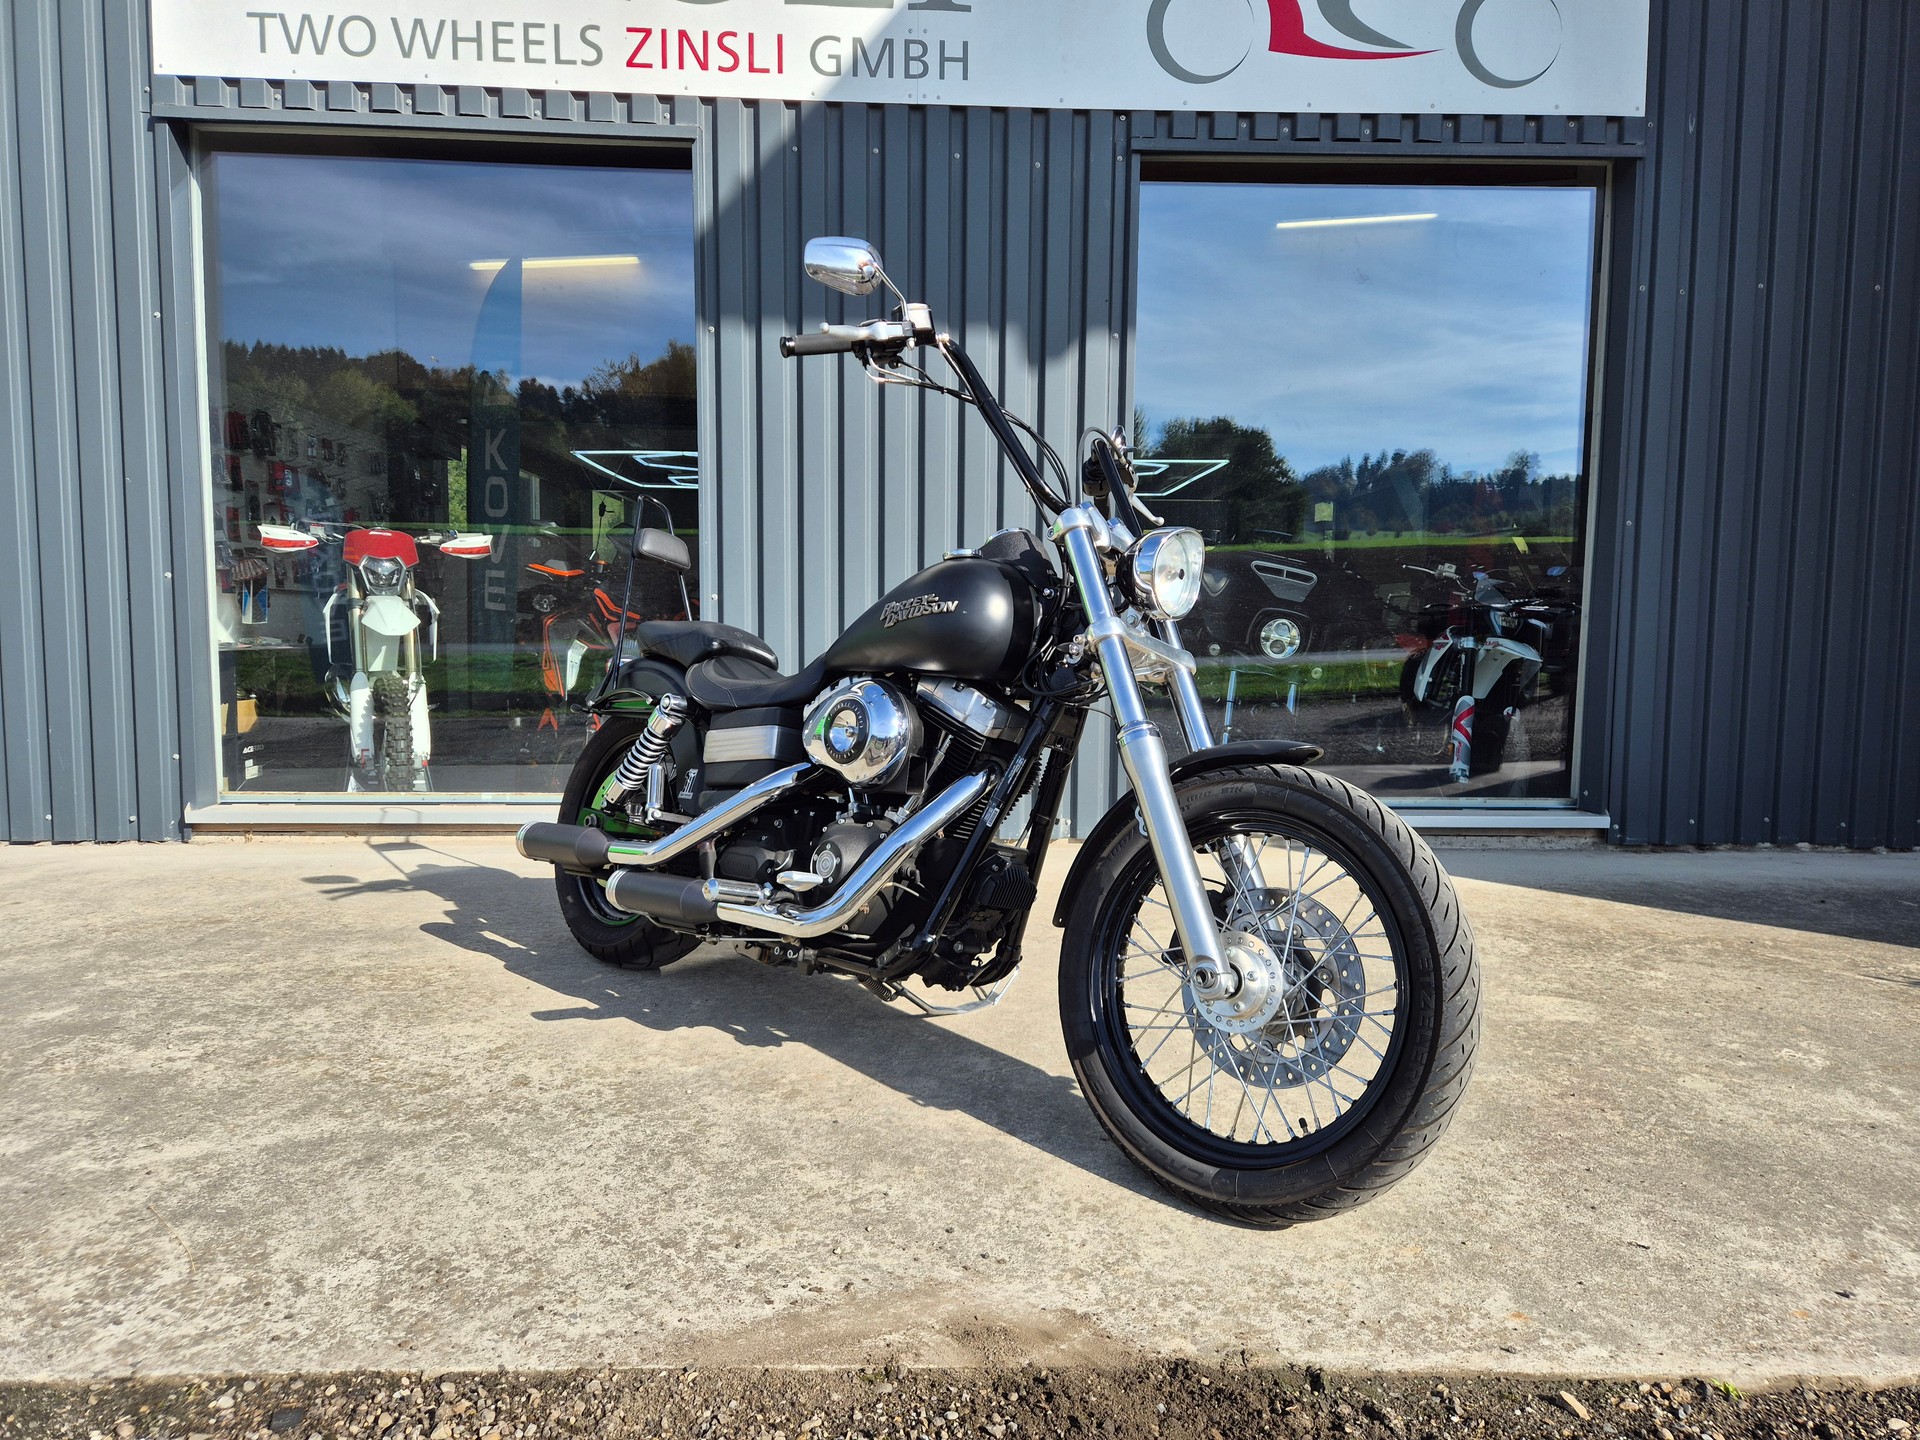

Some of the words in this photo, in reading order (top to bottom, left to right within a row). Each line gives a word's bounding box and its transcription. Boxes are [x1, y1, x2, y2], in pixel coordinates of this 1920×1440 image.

[246, 11, 377, 58] TWO
[390, 16, 605, 67] WHEELS
[625, 26, 785, 75] ZINSLI
[809, 35, 969, 81] GMBH
[484, 428, 509, 613] KOVE
[883, 600, 959, 628] DAVIDSON
